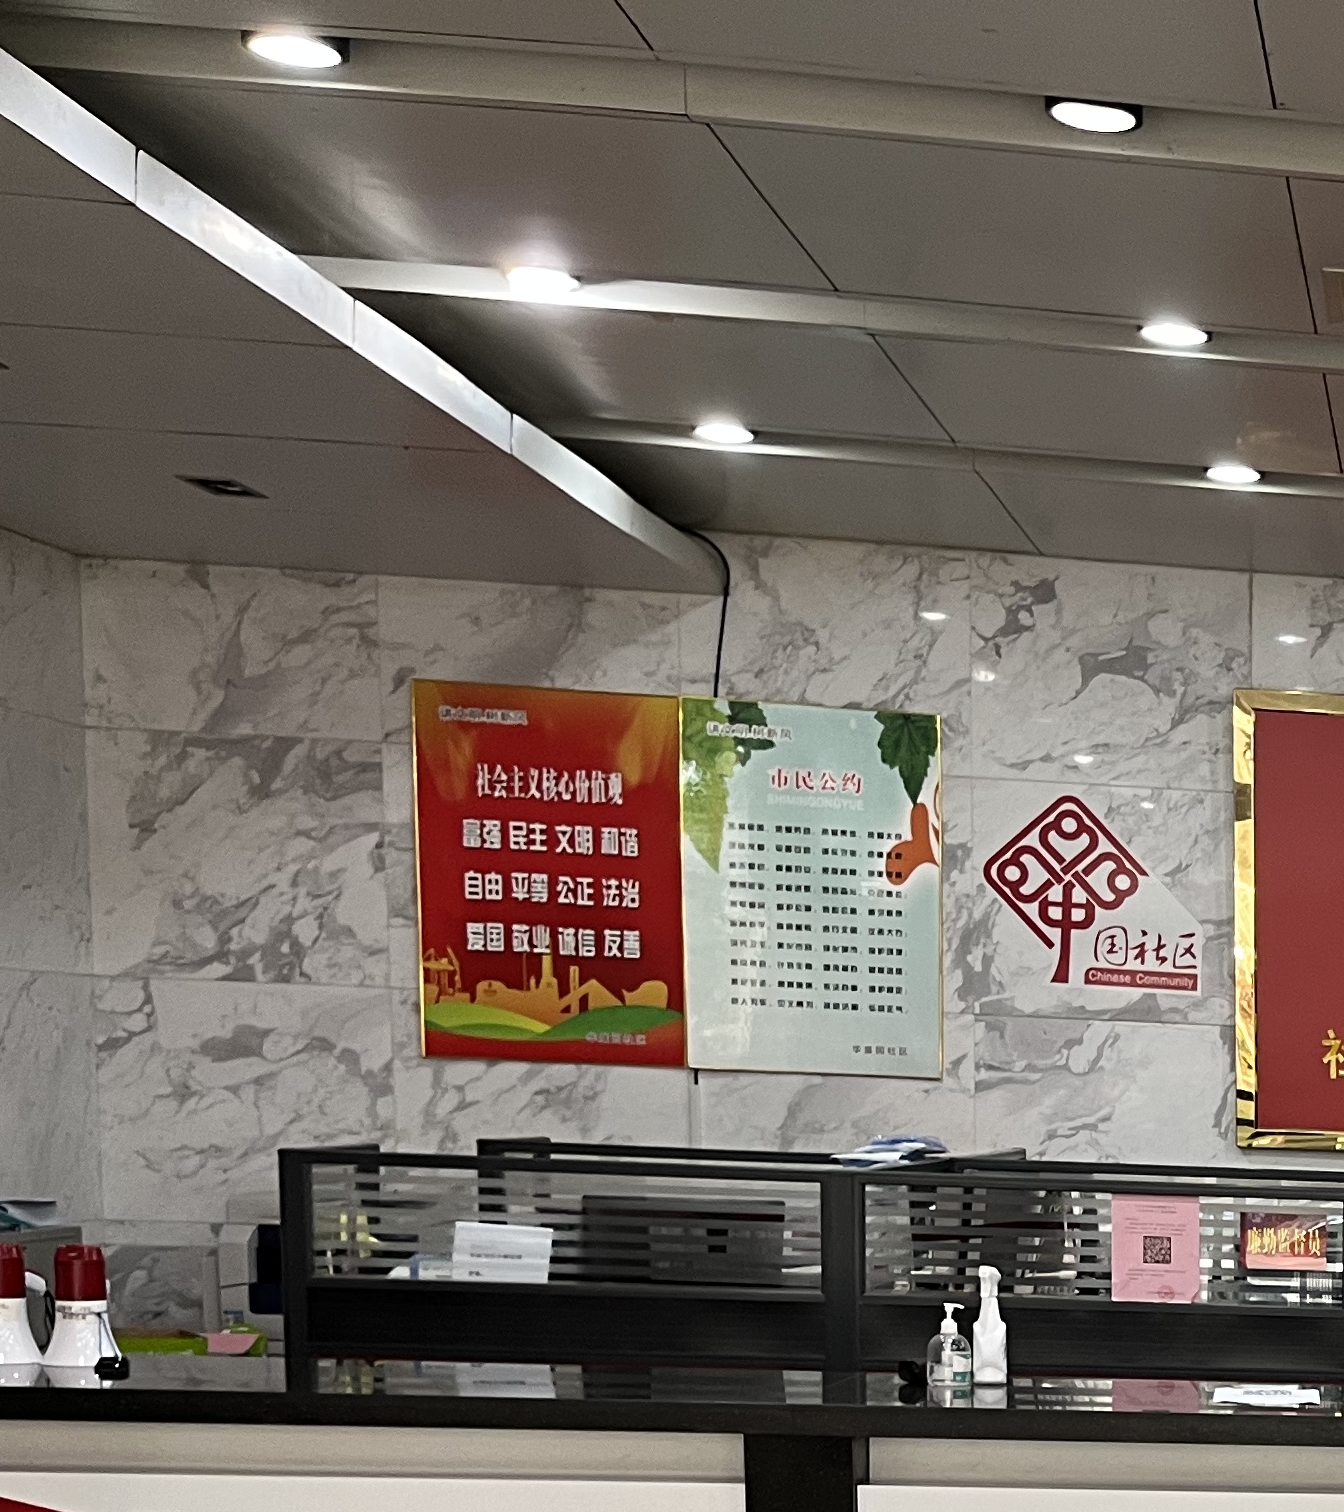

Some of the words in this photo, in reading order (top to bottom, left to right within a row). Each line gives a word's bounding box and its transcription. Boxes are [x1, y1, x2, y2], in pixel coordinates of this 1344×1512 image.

[476, 762, 623, 805] 社会主义核心价值观
[770, 767, 864, 794] 市民公约
[462, 818, 501, 849] 富强
[508, 820, 548, 852] 民主
[554, 824, 594, 855] 文明
[600, 826, 640, 857] 和谐
[464, 870, 503, 901] 自由
[510, 871, 549, 903] 平等
[556, 875, 595, 906] 公正
[601, 877, 640, 908] 法治
[466, 922, 505, 952] 爱国
[511, 923, 551, 953] 敬业
[557, 926, 596, 957] 诚信
[603, 928, 641, 959] 友善
[1088, 970, 1132, 984] Chinese
[1136, 972, 1195, 989] Community
